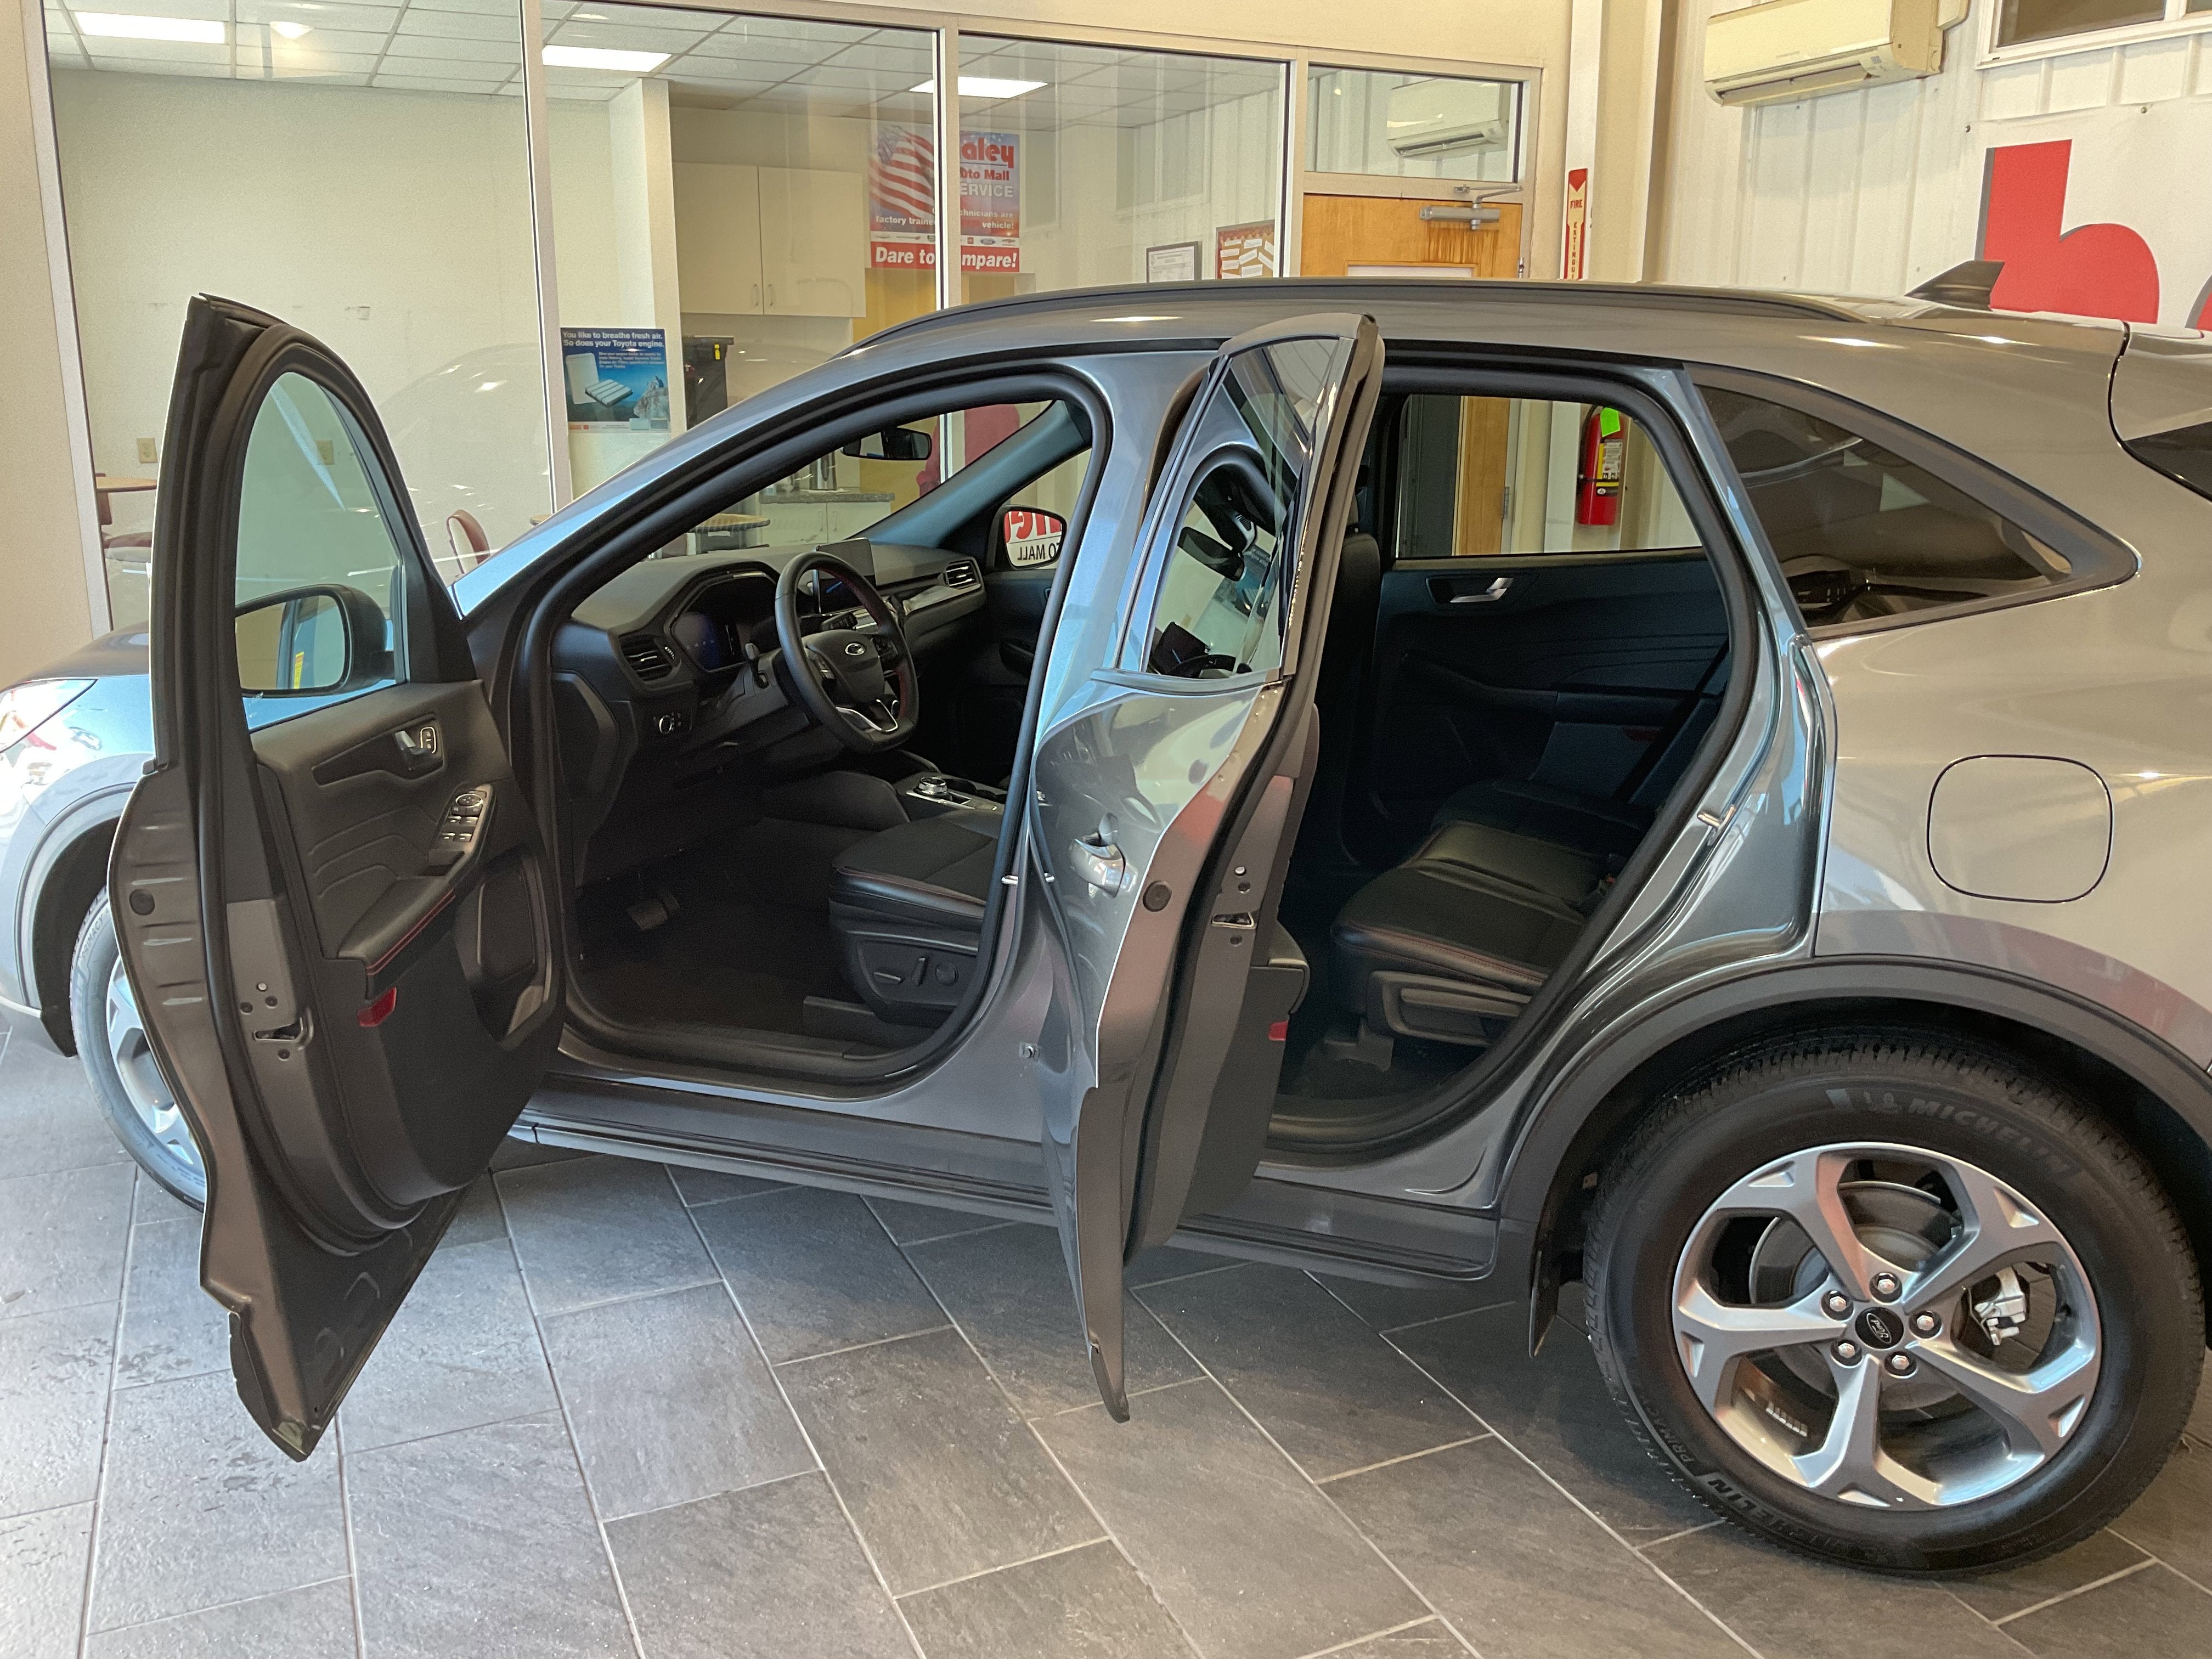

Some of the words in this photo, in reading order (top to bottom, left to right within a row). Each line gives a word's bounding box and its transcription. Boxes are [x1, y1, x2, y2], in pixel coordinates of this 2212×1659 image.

[960, 167, 980, 179] uto
[984, 169, 1009, 180] Mall
[1570, 199, 1583, 209] FIRE
[876, 216, 907, 225] factory
[876, 247, 914, 264] Dare
[919, 249, 935, 264] to
[1908, 1098, 2080, 1175] MICHELIN
